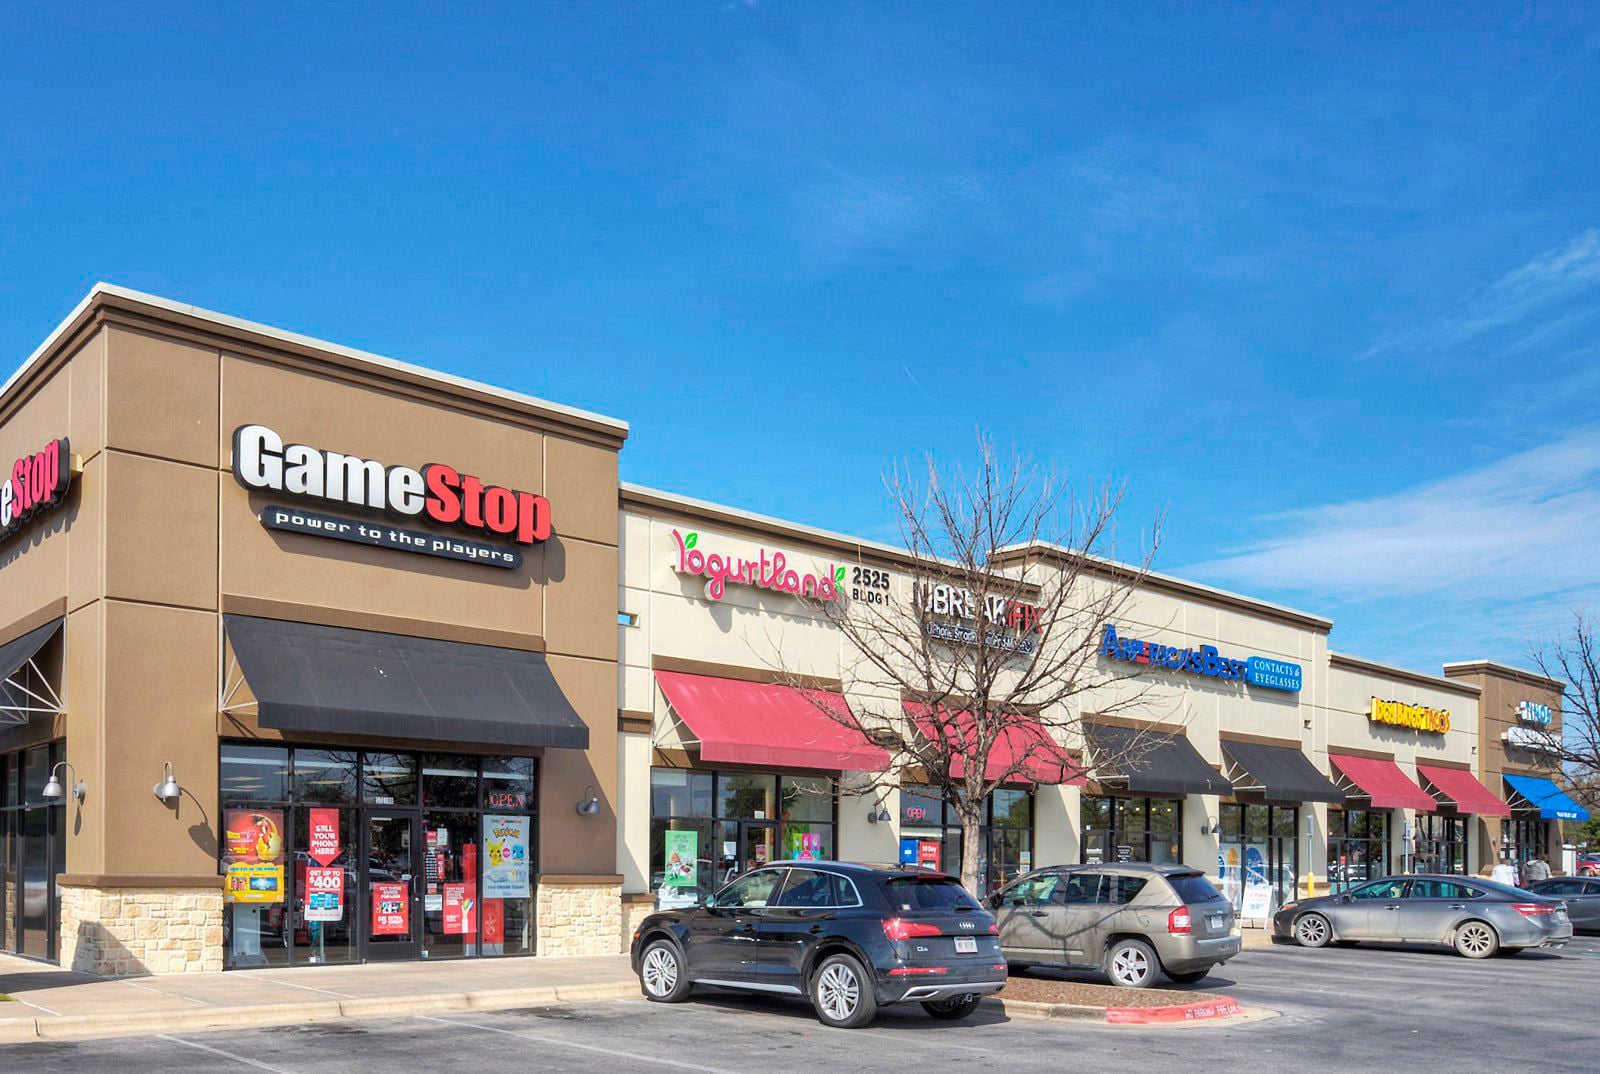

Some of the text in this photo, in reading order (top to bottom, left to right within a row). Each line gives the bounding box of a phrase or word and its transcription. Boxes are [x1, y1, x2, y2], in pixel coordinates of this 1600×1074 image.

[239, 424, 551, 544] GameStop
[275, 511, 514, 562] power to the players
[671, 528, 840, 600] Yogurtland
[852, 566, 890, 590] 2525
[852, 588, 889, 606] BLDG 1
[1253, 659, 1300, 677] CONTACTS &
[1255, 672, 1299, 690] EYEGLASSES
[489, 793, 525, 807] OPEN
[907, 806, 925, 819] OPEN
[309, 876, 341, 889] $400
